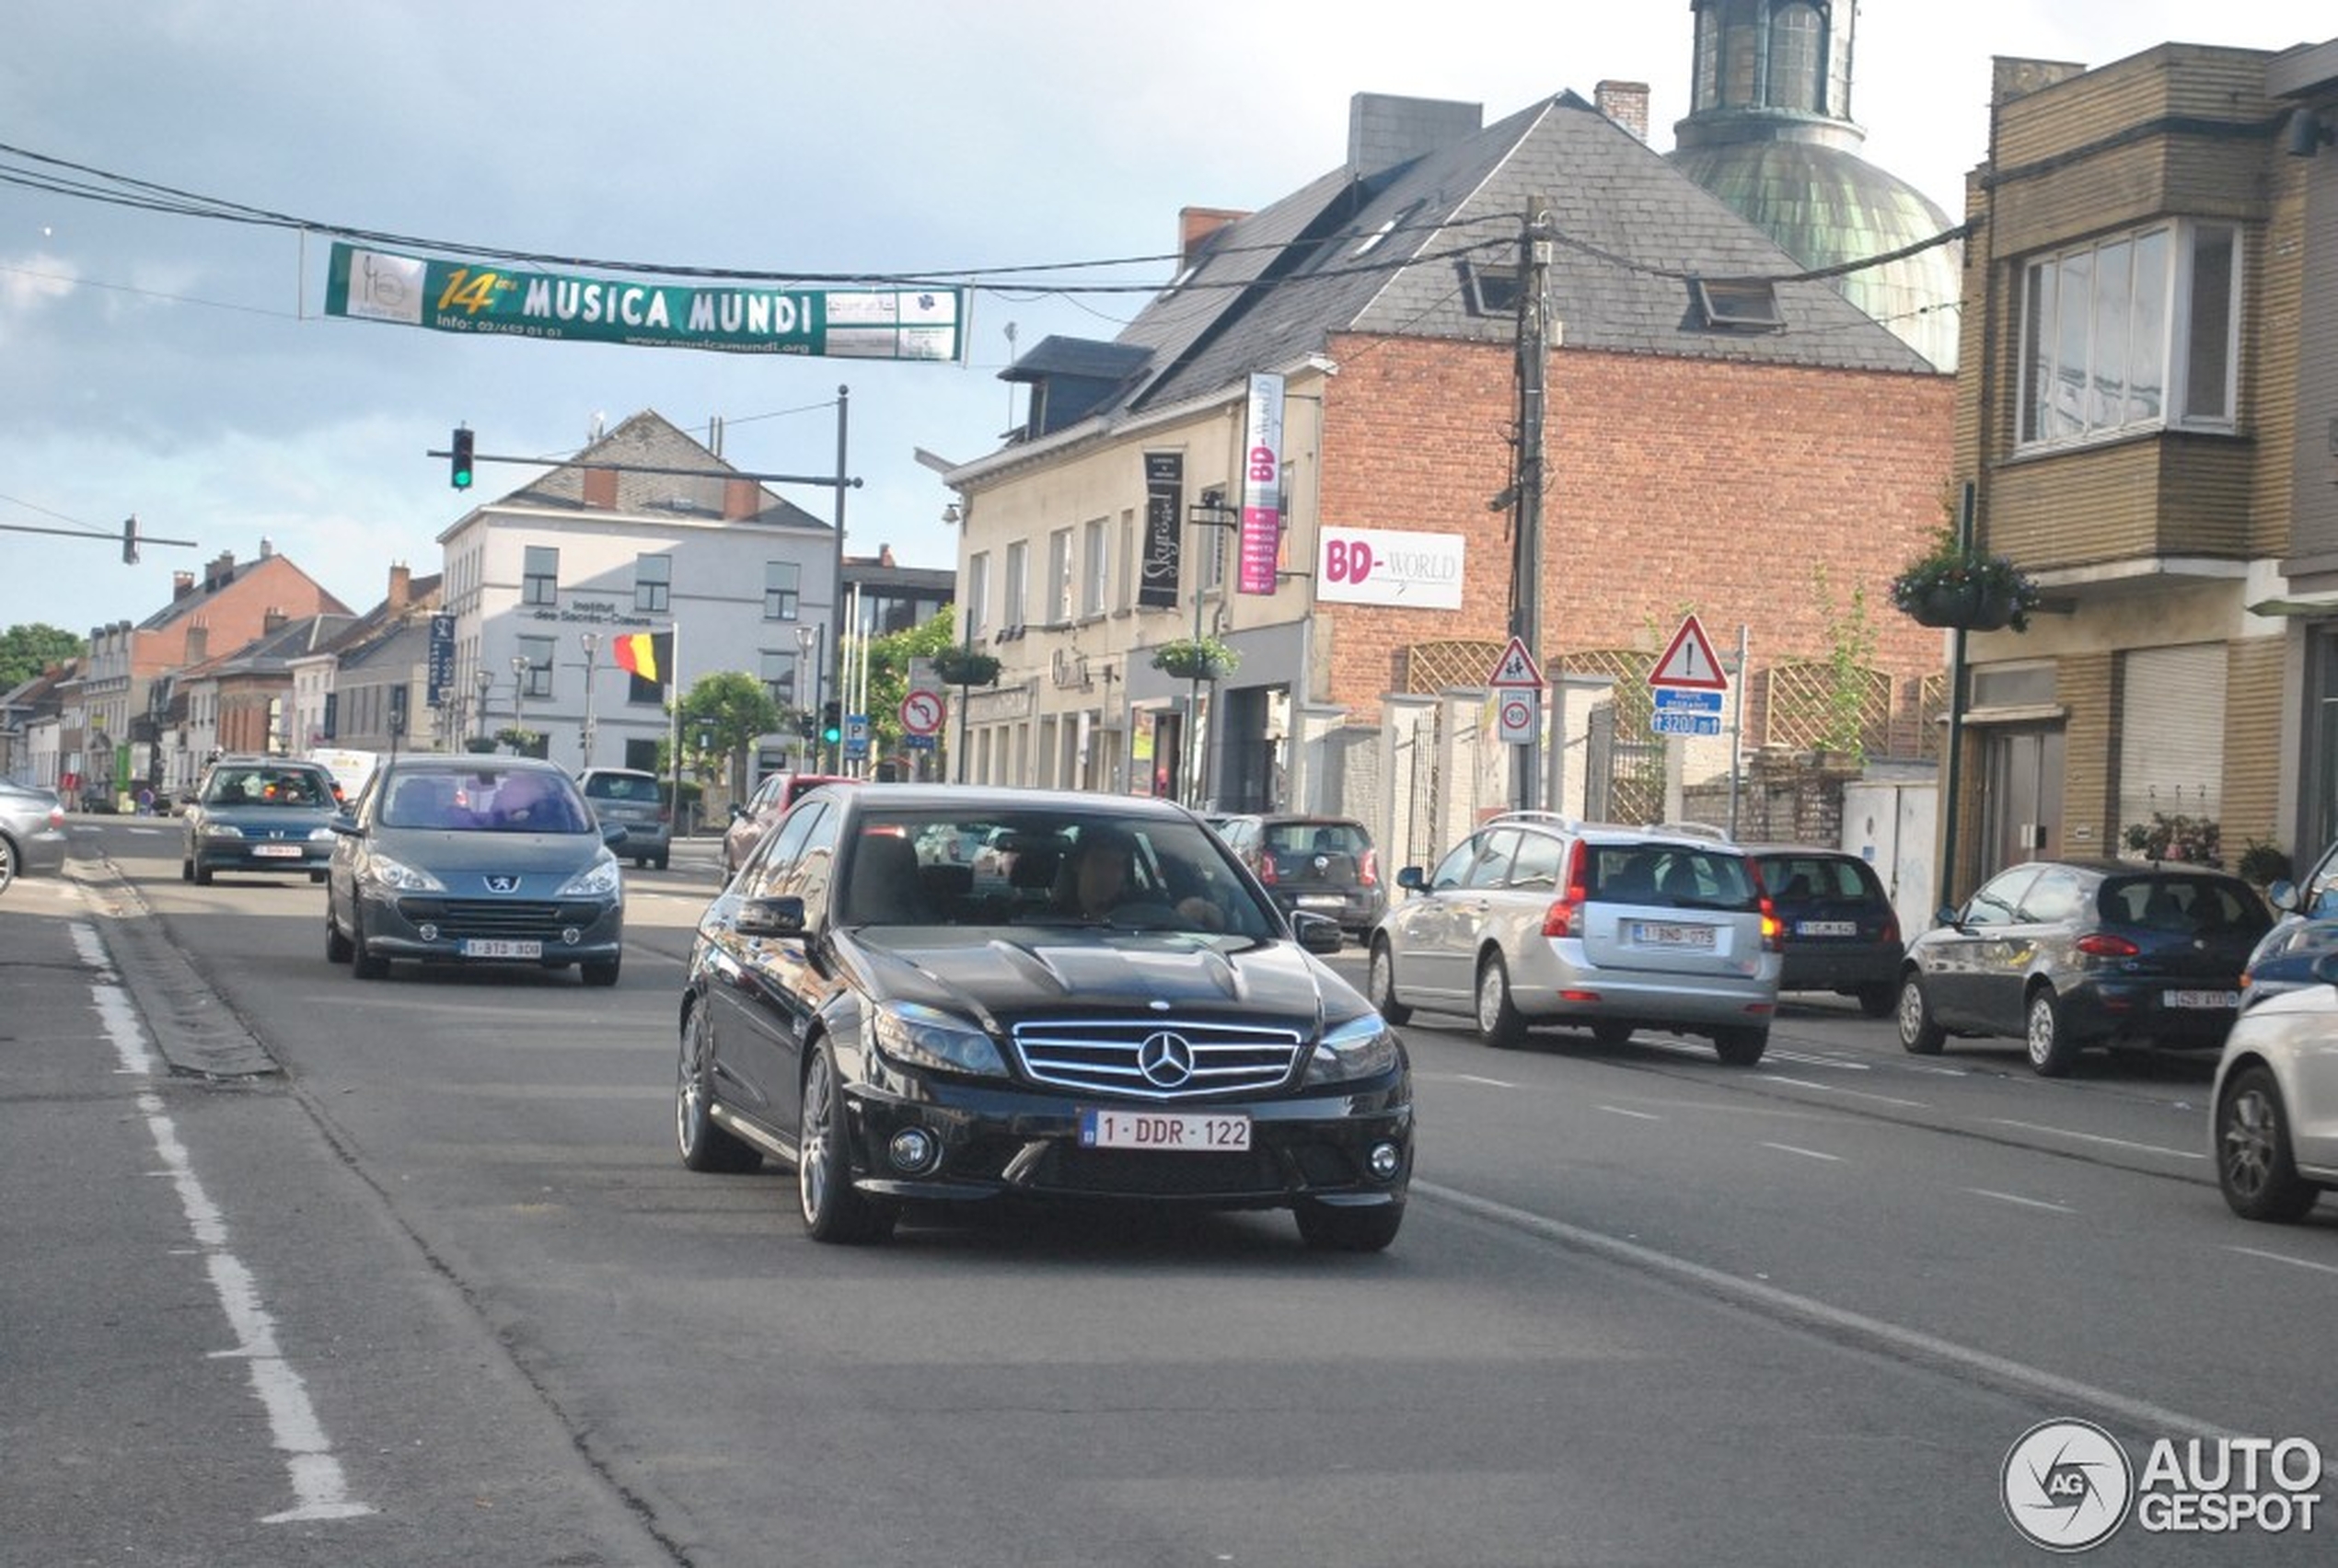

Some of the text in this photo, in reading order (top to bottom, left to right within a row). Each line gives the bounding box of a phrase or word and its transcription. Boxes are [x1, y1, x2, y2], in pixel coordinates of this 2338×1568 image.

[523, 279, 670, 329] MUSICA
[689, 294, 812, 335] MUNDI
[625, 335, 810, 355] www.musicamundi.org
[851, 724, 862, 738] P
